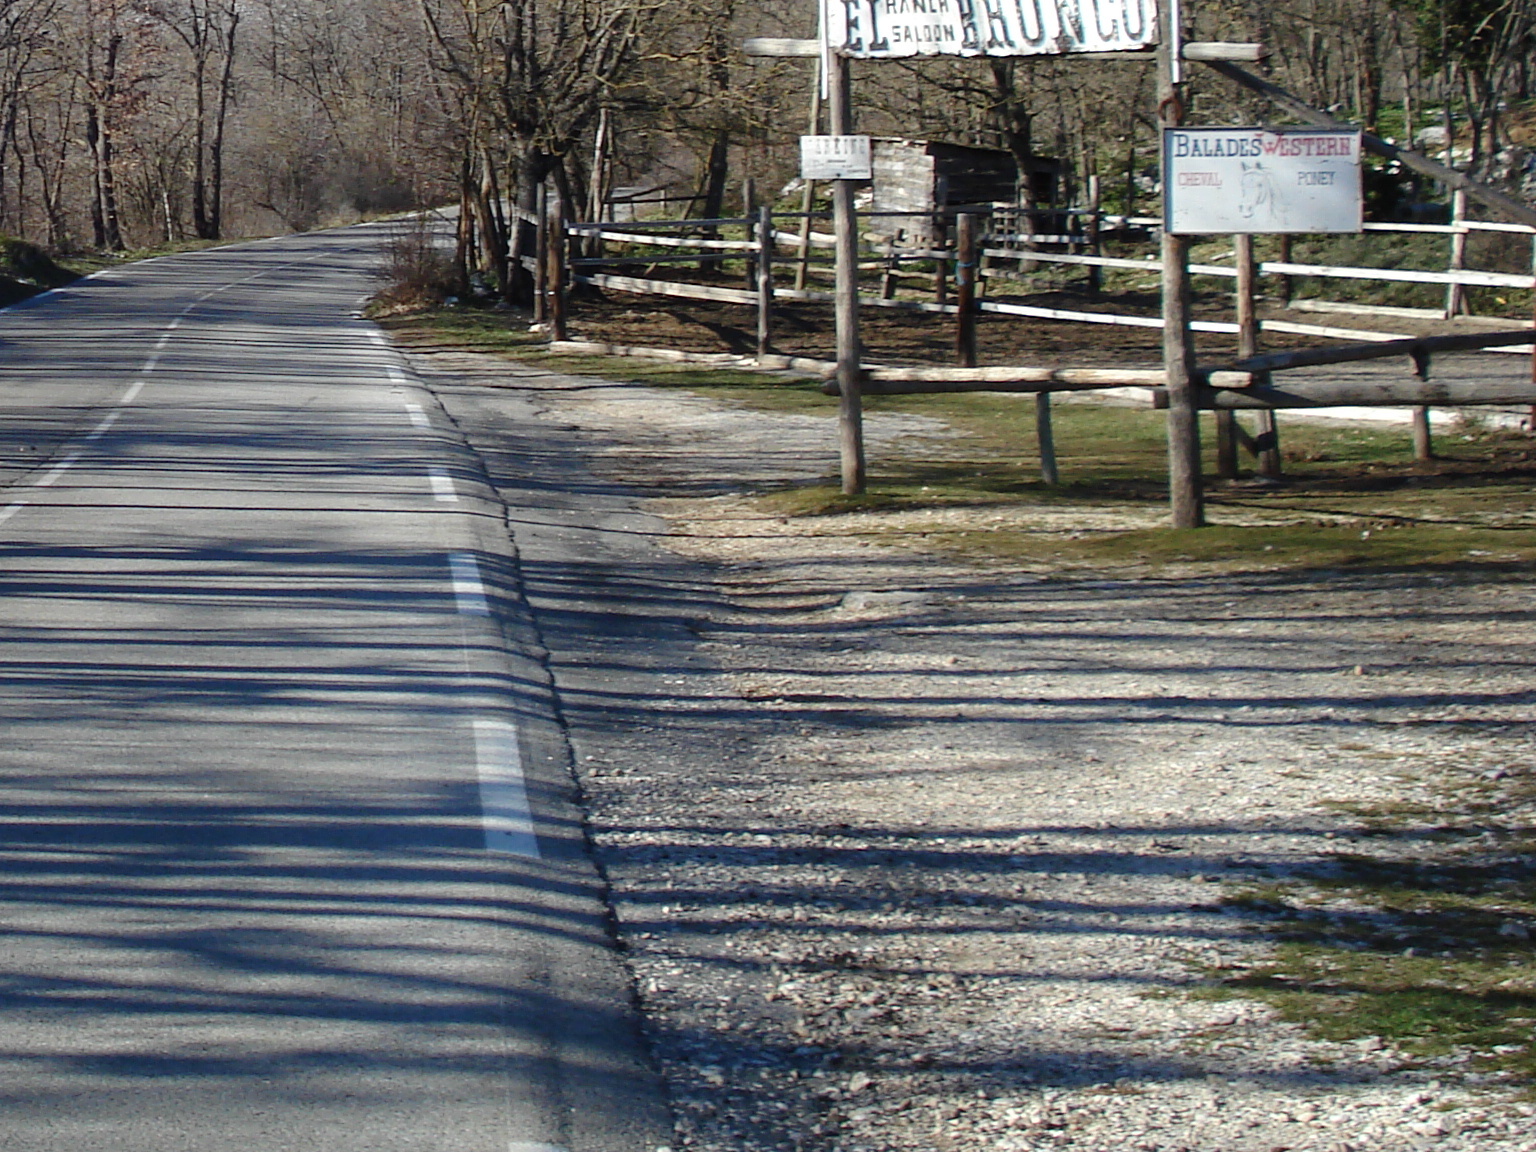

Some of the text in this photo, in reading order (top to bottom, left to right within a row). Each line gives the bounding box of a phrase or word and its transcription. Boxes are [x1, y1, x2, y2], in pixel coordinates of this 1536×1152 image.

[892, 24, 955, 43] SALOON
[1174, 134, 1263, 158] BALADES
[1177, 171, 1336, 187] CHEVAL PONEY
